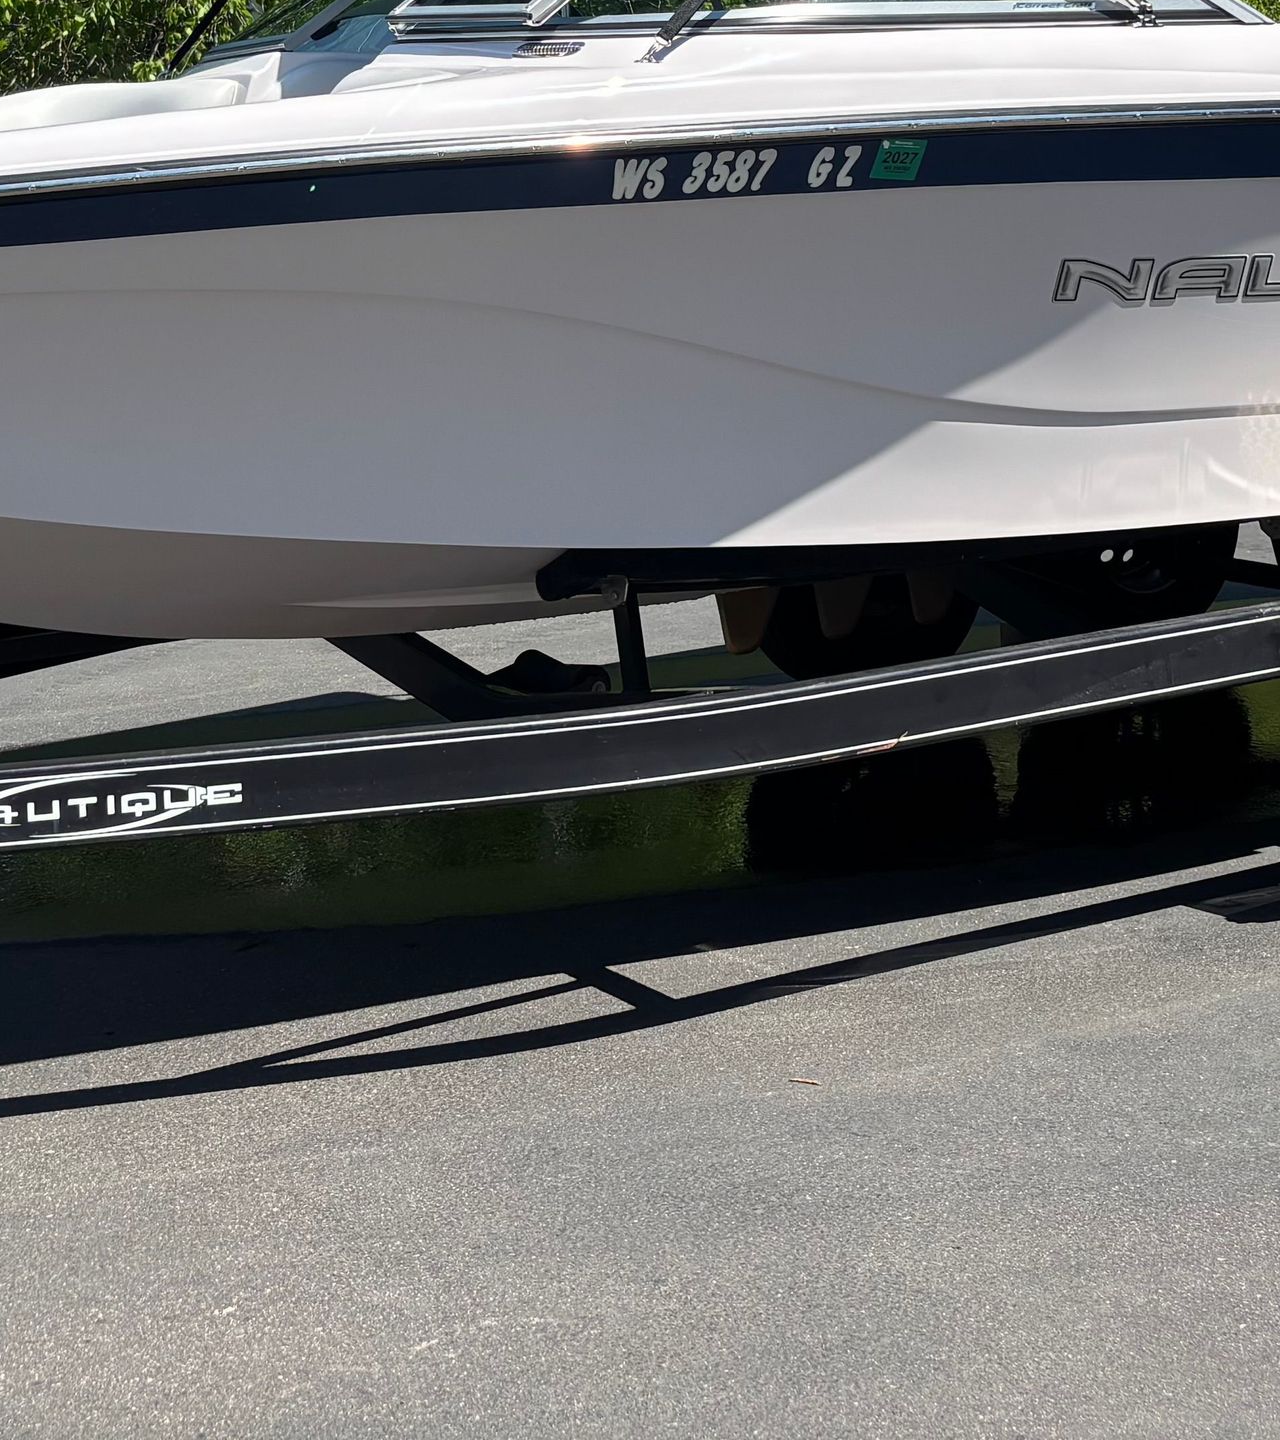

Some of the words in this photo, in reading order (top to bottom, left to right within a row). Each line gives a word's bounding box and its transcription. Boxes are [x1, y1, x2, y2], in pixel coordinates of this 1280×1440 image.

[611, 156, 668, 200] WS
[681, 148, 778, 194] 3587
[881, 150, 920, 165] 2027
